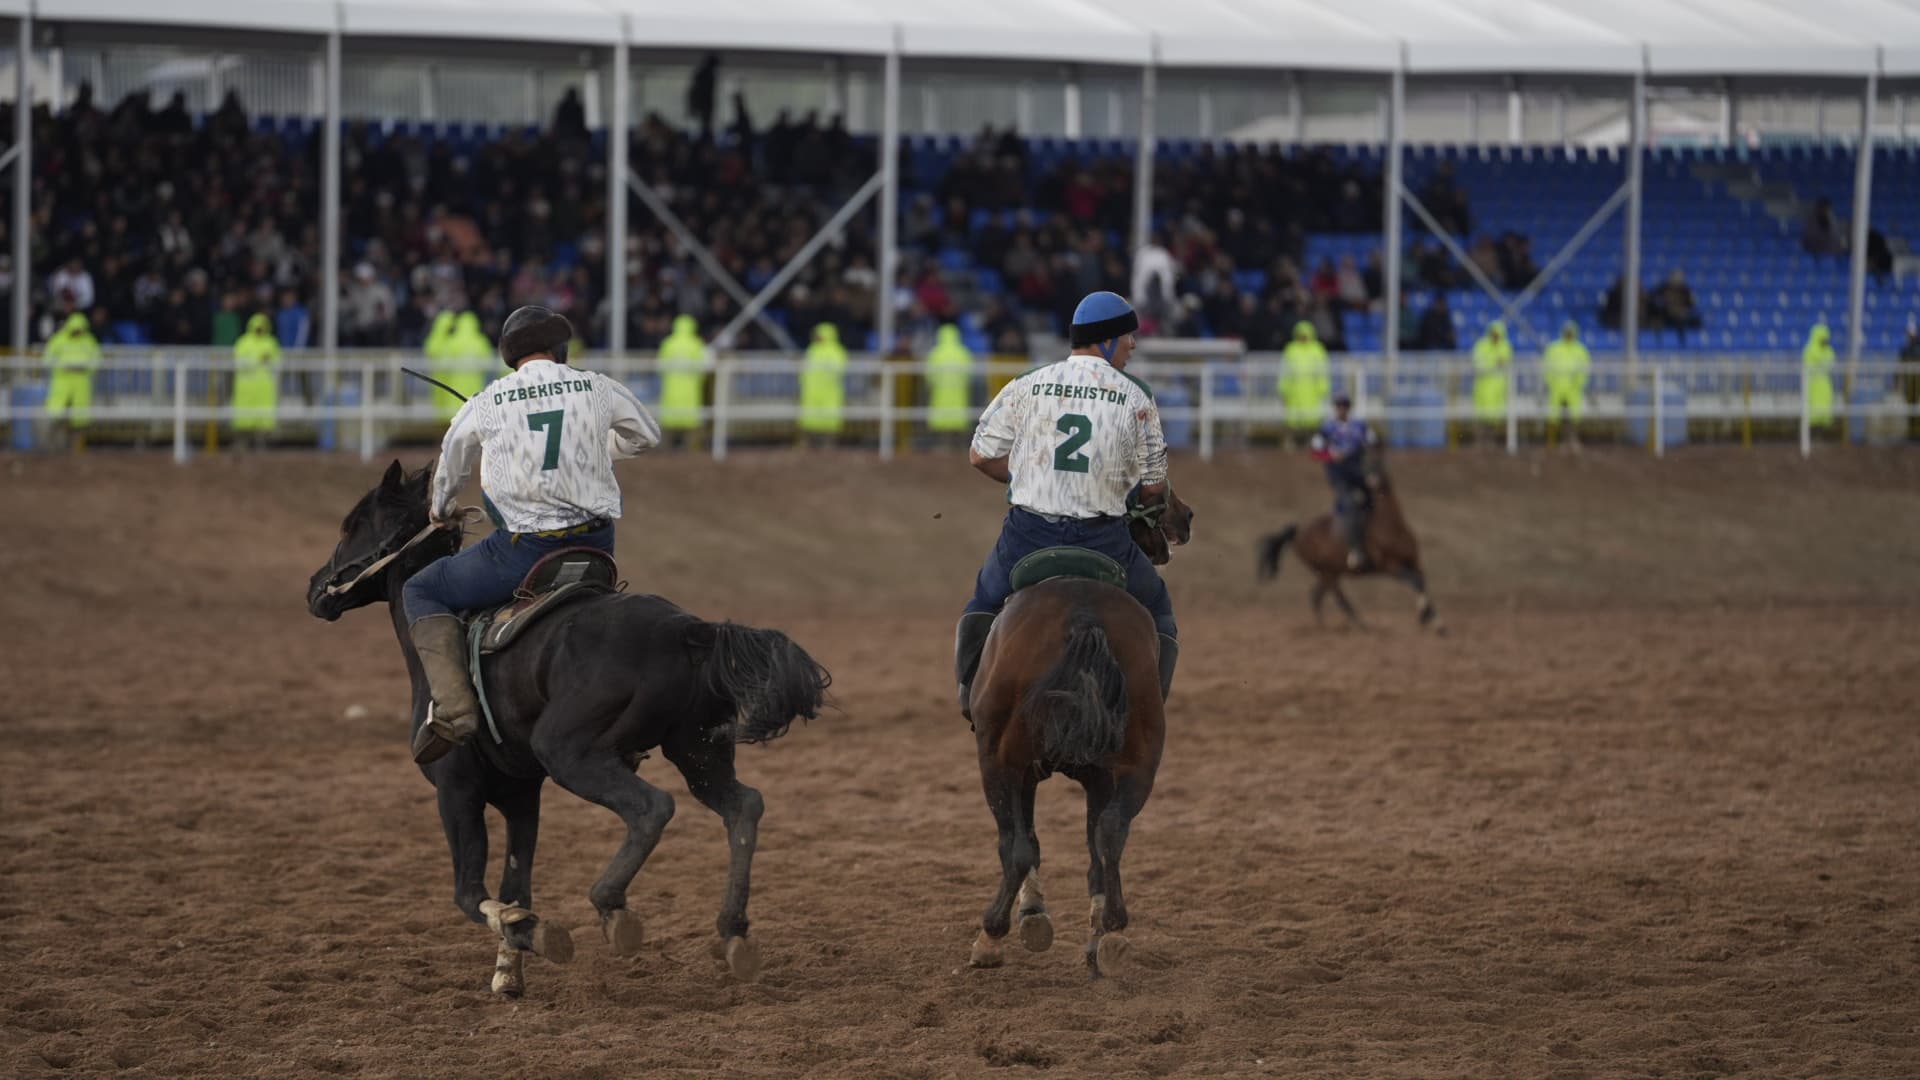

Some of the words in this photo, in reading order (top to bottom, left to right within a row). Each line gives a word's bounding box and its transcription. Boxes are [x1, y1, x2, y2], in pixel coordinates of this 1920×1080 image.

[494, 379, 593, 405] O'ZBEKISTON
[1032, 383, 1127, 406] O'ZBEKISTON
[527, 409, 565, 471] 7
[1053, 413, 1092, 473] 2
